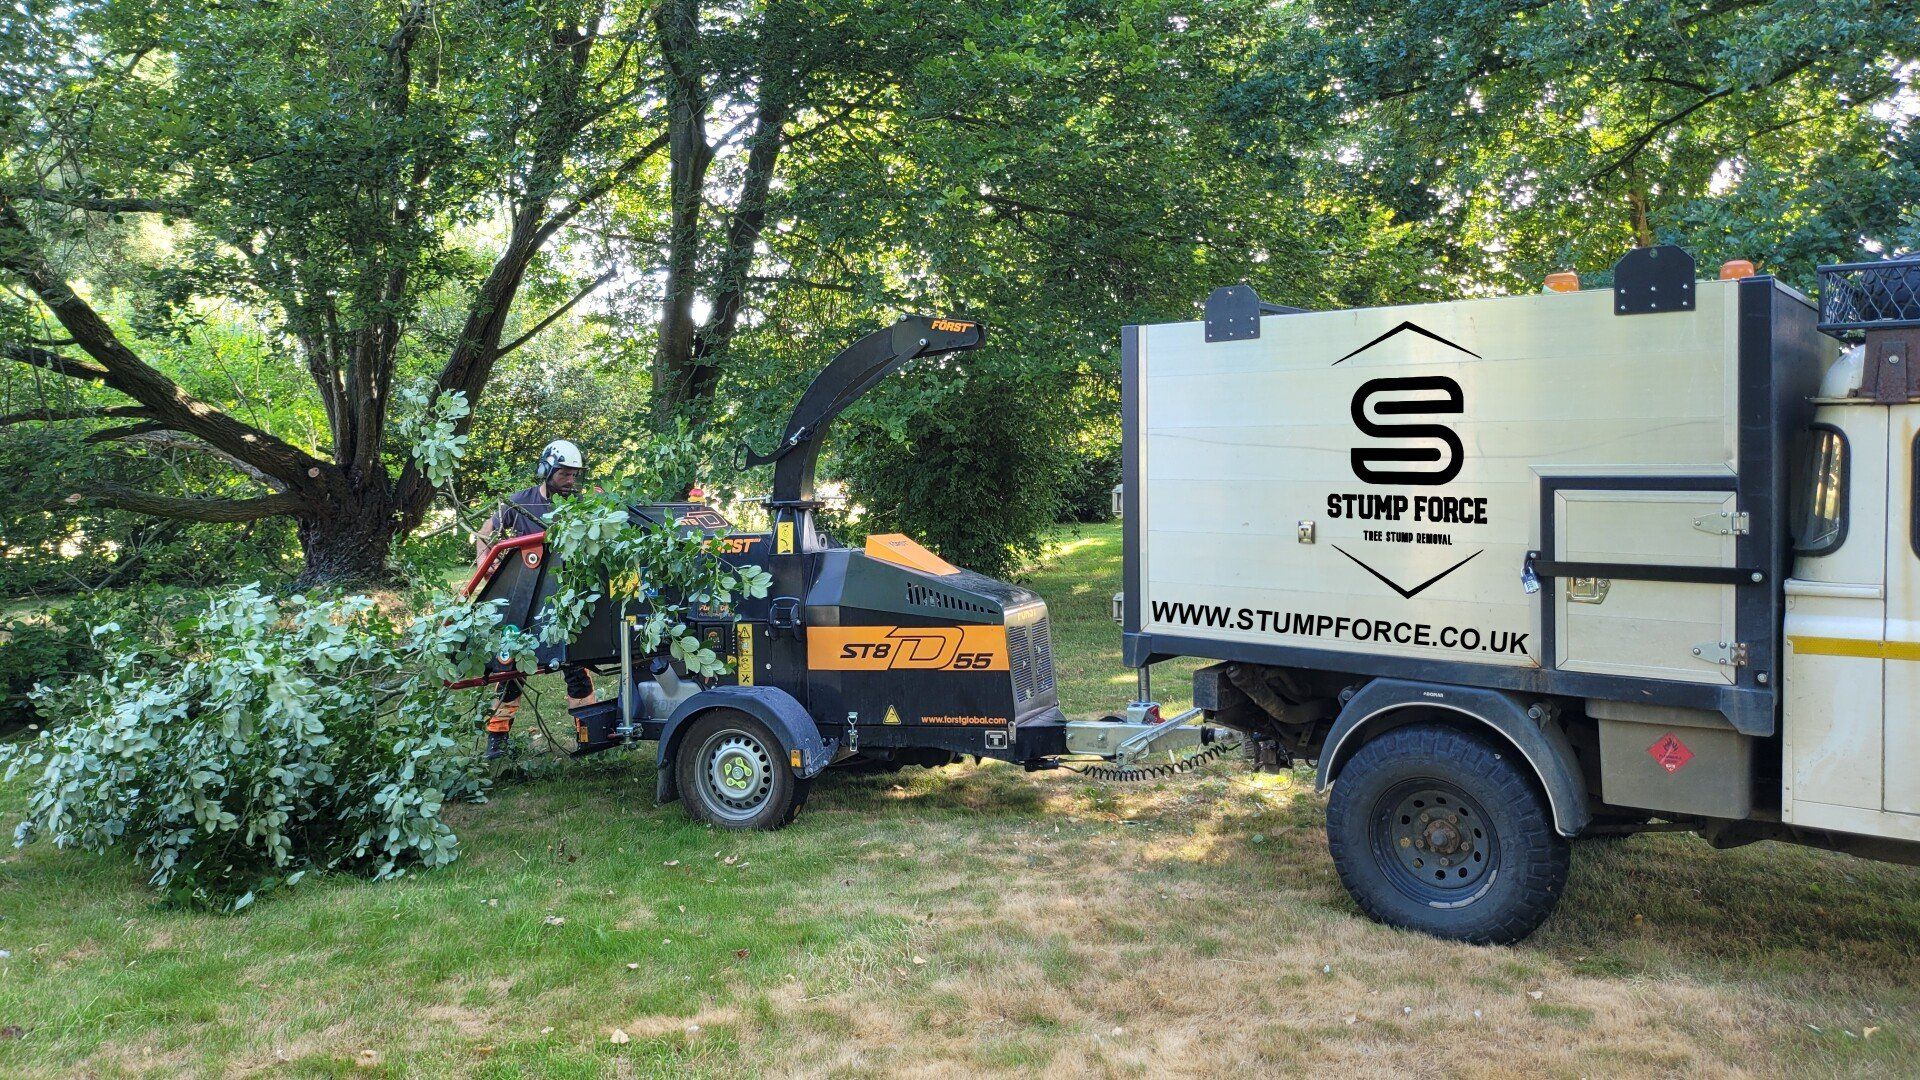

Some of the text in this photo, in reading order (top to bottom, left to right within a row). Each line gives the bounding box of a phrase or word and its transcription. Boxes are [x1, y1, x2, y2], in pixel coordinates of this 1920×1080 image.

[1327, 493, 1488, 525] STUMP FORCE
[1363, 530, 1453, 546] TREE STUMP REMOVAL
[1151, 600, 1530, 655] WWW.STUMPFORCE.CO.UK
[840, 643, 892, 659] ST8
[953, 653, 993, 669] 55
